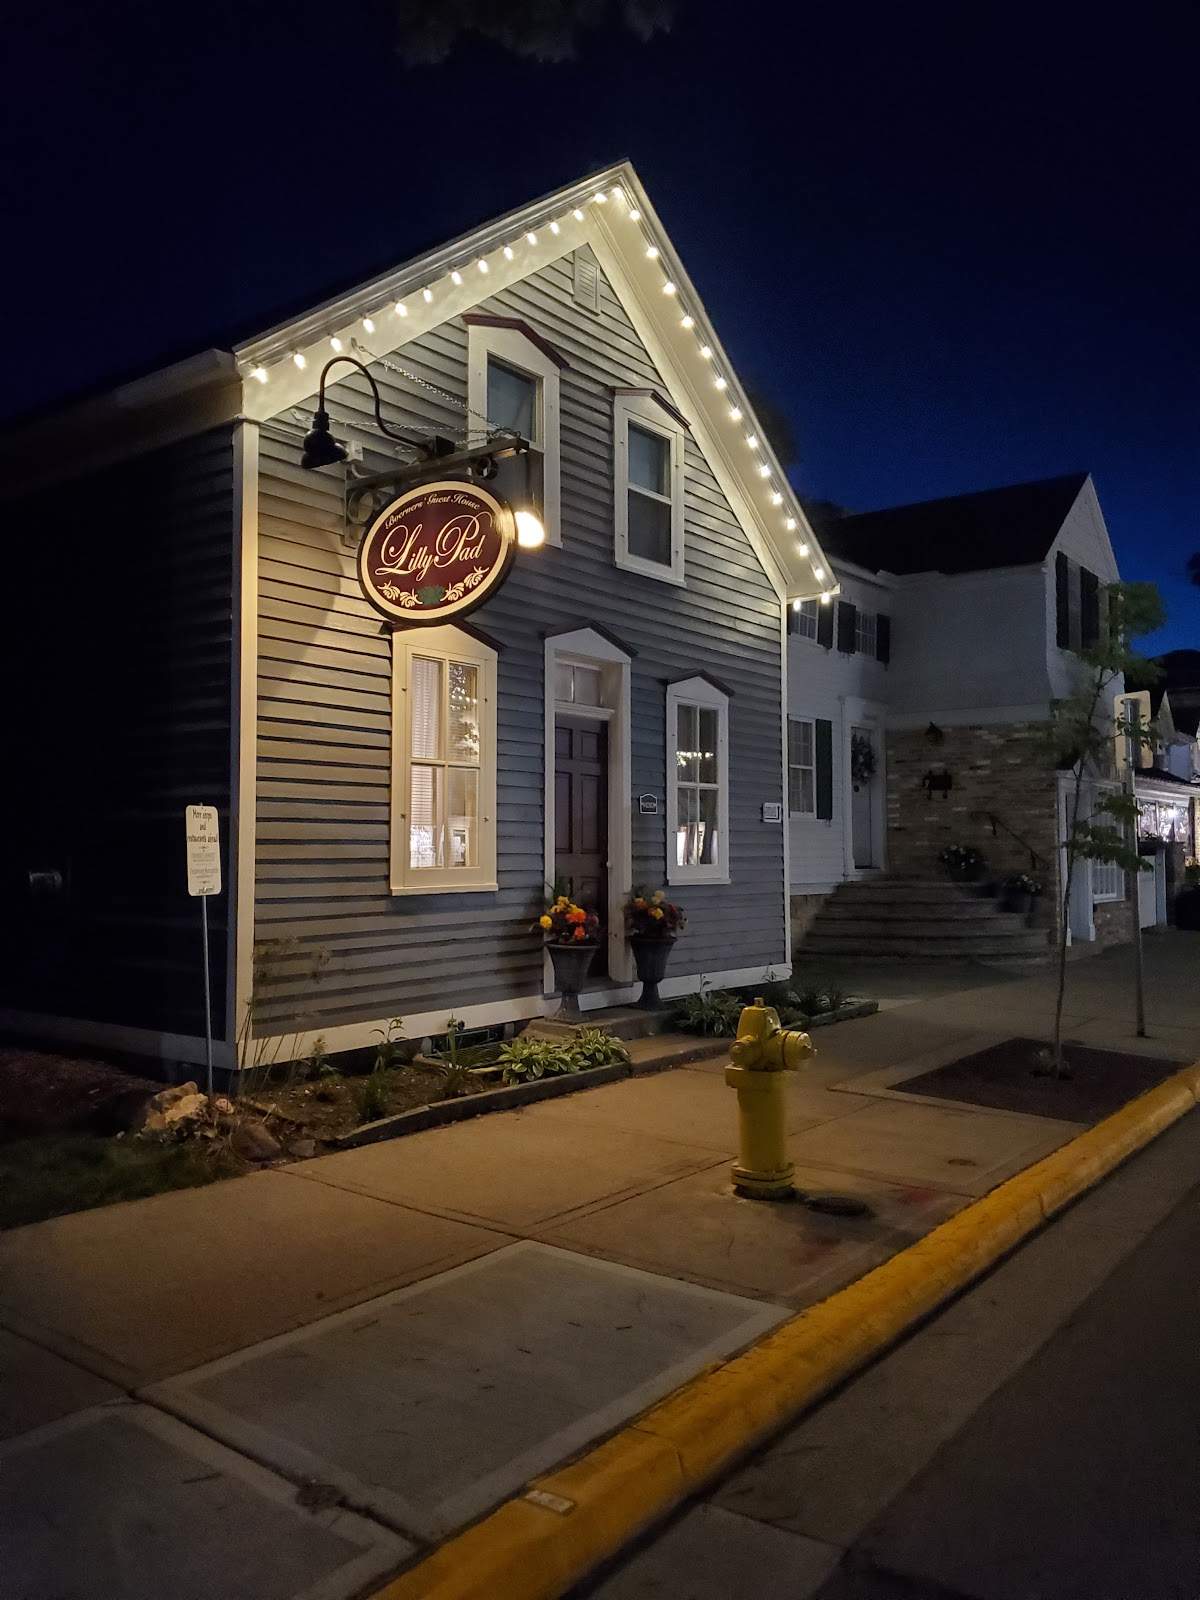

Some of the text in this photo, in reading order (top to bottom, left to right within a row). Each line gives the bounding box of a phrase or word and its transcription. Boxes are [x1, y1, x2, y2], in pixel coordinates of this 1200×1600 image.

[427, 493, 452, 505] Guest
[451, 493, 480, 510] House
[375, 511, 493, 581] Lilly Pad
